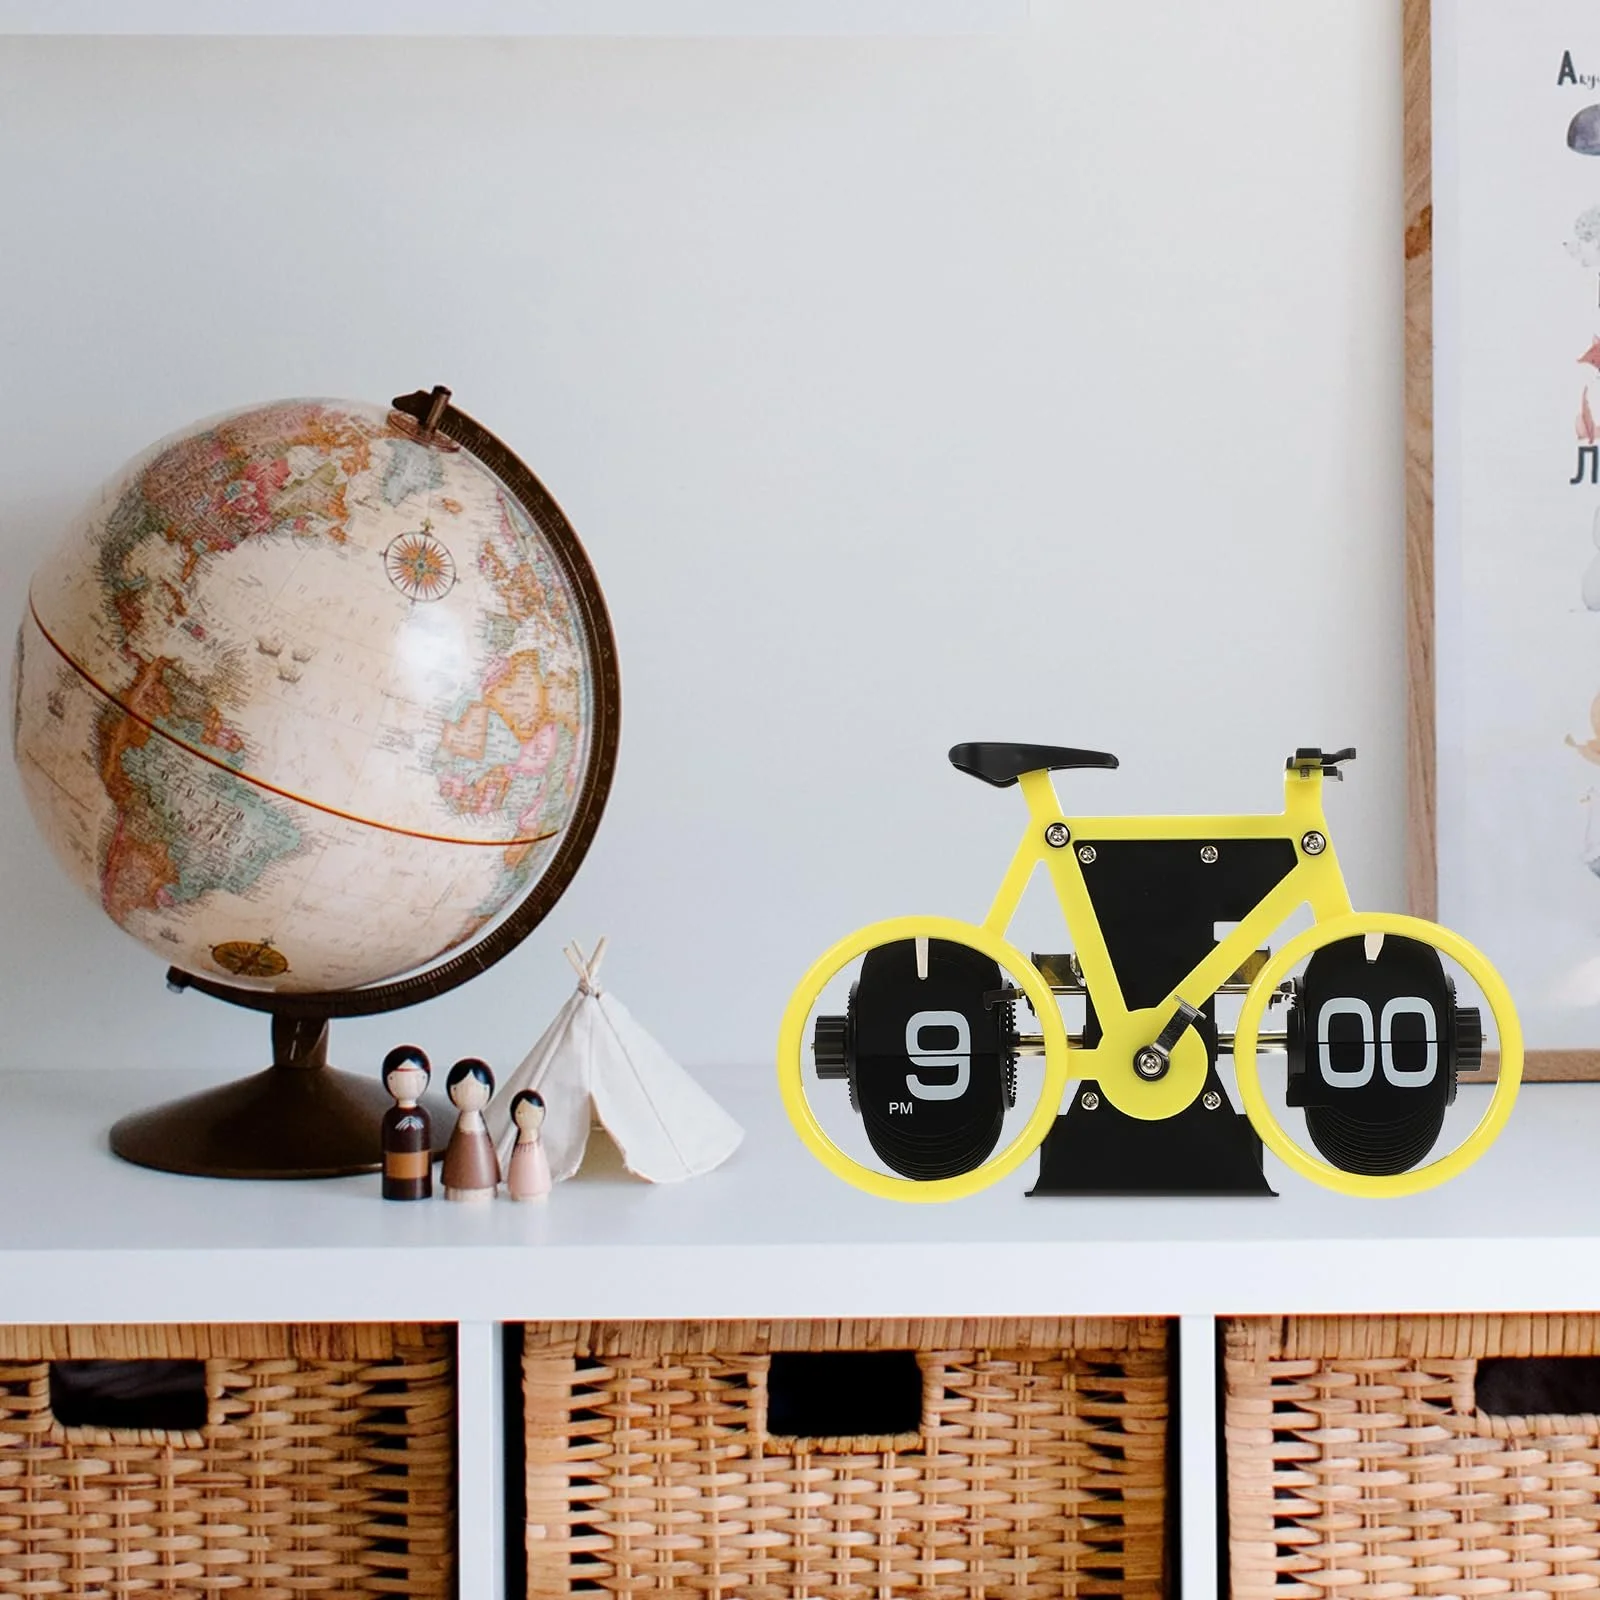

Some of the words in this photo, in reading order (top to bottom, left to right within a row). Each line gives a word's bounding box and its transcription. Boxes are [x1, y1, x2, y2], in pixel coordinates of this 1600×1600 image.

[905, 1010, 971, 1101] 9
[1317, 996, 1438, 1088] 00
[888, 1101, 913, 1115] PM
